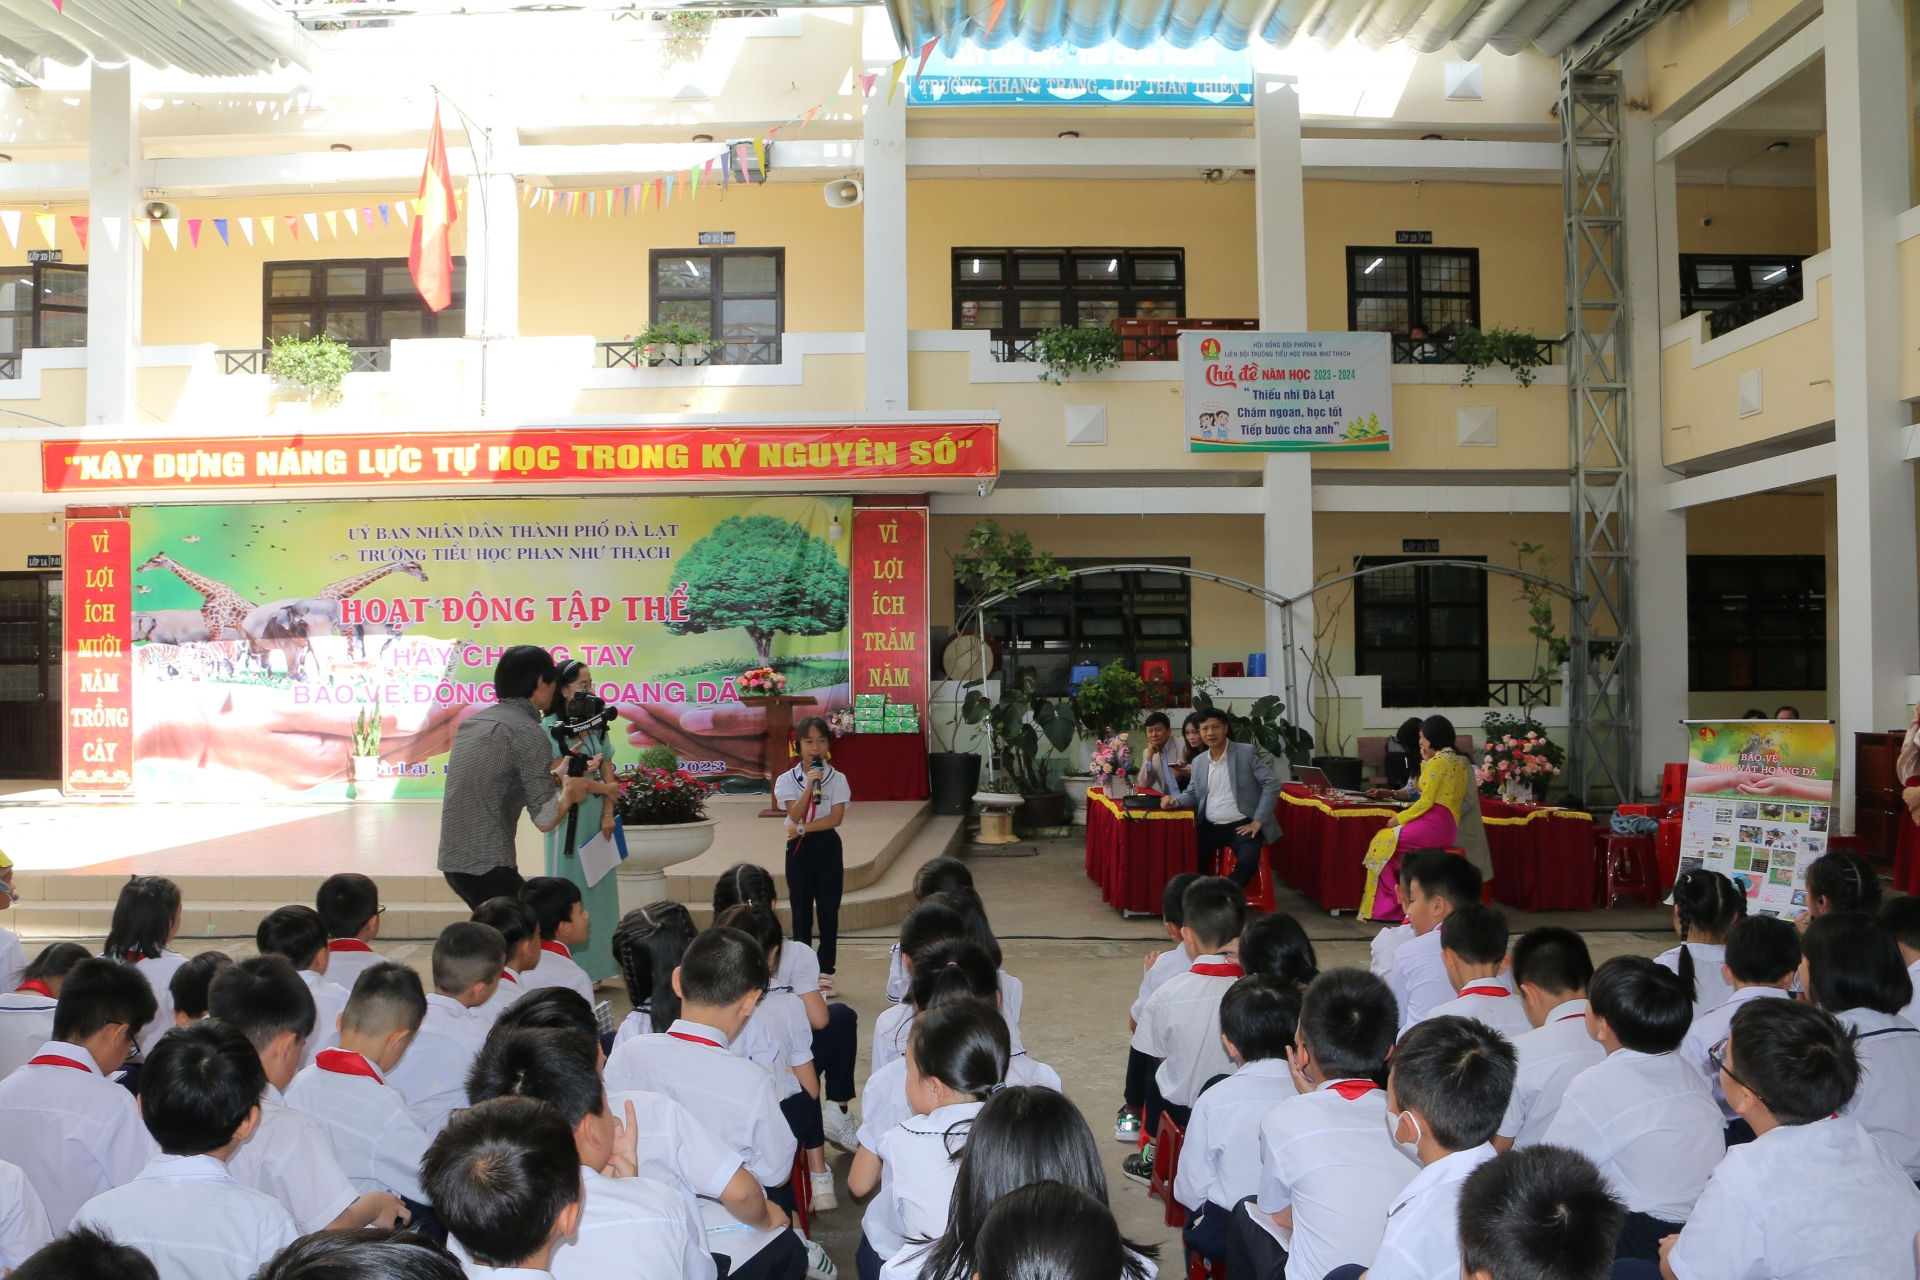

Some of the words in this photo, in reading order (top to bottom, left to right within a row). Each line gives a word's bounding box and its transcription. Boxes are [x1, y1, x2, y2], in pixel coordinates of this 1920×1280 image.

[988, 78, 1041, 95] KHANG
[1046, 78, 1098, 94] TRANG
[1205, 363, 1237, 389] Chủ
[1239, 362, 1259, 381] đề
[1262, 367, 1286, 380] NĂM
[1289, 369, 1310, 382] HỌC
[1314, 368, 1331, 381] 2023
[1338, 368, 1356, 381] 2024
[1253, 387, 1281, 400] Thiếu
[1284, 389, 1300, 400] nhi
[1303, 388, 1316, 400] Đà
[1319, 389, 1335, 402] Lạt
[1237, 407, 1267, 418] Chăm
[1269, 409, 1304, 419] ngoan,
[1307, 407, 1326, 420] học
[1329, 405, 1343, 417] tốt
[1241, 423, 1262, 436] Tiếp
[1265, 424, 1291, 435] bước
[1293, 424, 1312, 435] cha
[153, 449, 245, 483] DỰNG
[256, 446, 347, 477] NĂNG
[358, 444, 422, 478] LỰC
[432, 443, 481, 477] TỰ
[488, 445, 560, 475] HỌC
[571, 444, 689, 470] TRONG
[702, 437, 748, 469] KỶ
[759, 438, 897, 468] NGUYÊN
[91, 529, 109, 553] VÌ
[348, 524, 371, 540] UỶ
[376, 527, 411, 540] BAN
[416, 522, 464, 539] NHÂN
[468, 522, 504, 539] DÂN
[509, 522, 569, 538] THÀNH
[574, 519, 610, 537] PHỐ
[615, 521, 639, 537] ĐÀ
[644, 524, 679, 540] LẠT
[878, 519, 898, 543] VÌ
[358, 545, 426, 562] TRƯỜNG
[432, 542, 473, 561] TIỂU
[477, 547, 512, 563] HỌC
[517, 547, 564, 560] PHAN
[569, 545, 605, 560] NHƯ
[611, 546, 671, 562] THẠCH
[85, 566, 114, 592] LỢI
[873, 557, 904, 583] LỢI
[84, 599, 115, 623] ÍCH
[340, 598, 430, 630] HOẠT
[441, 590, 535, 629] ĐỘNG
[546, 589, 611, 629] TẬP
[621, 582, 689, 622] THỂ
[872, 591, 905, 615] ÍCH
[77, 633, 122, 658] MƯỜI
[862, 627, 915, 651] TRĂM
[463, 645, 570, 667] CHG
[580, 646, 635, 666] TAY
[80, 668, 119, 692] NĂM
[868, 662, 910, 687] NĂM
[414, 678, 499, 708] ĐỘNG
[590, 682, 685, 704] OANG
[697, 676, 739, 703] DÃ
[70, 697, 129, 727] TRỒNG
[82, 738, 118, 762] CÂY
